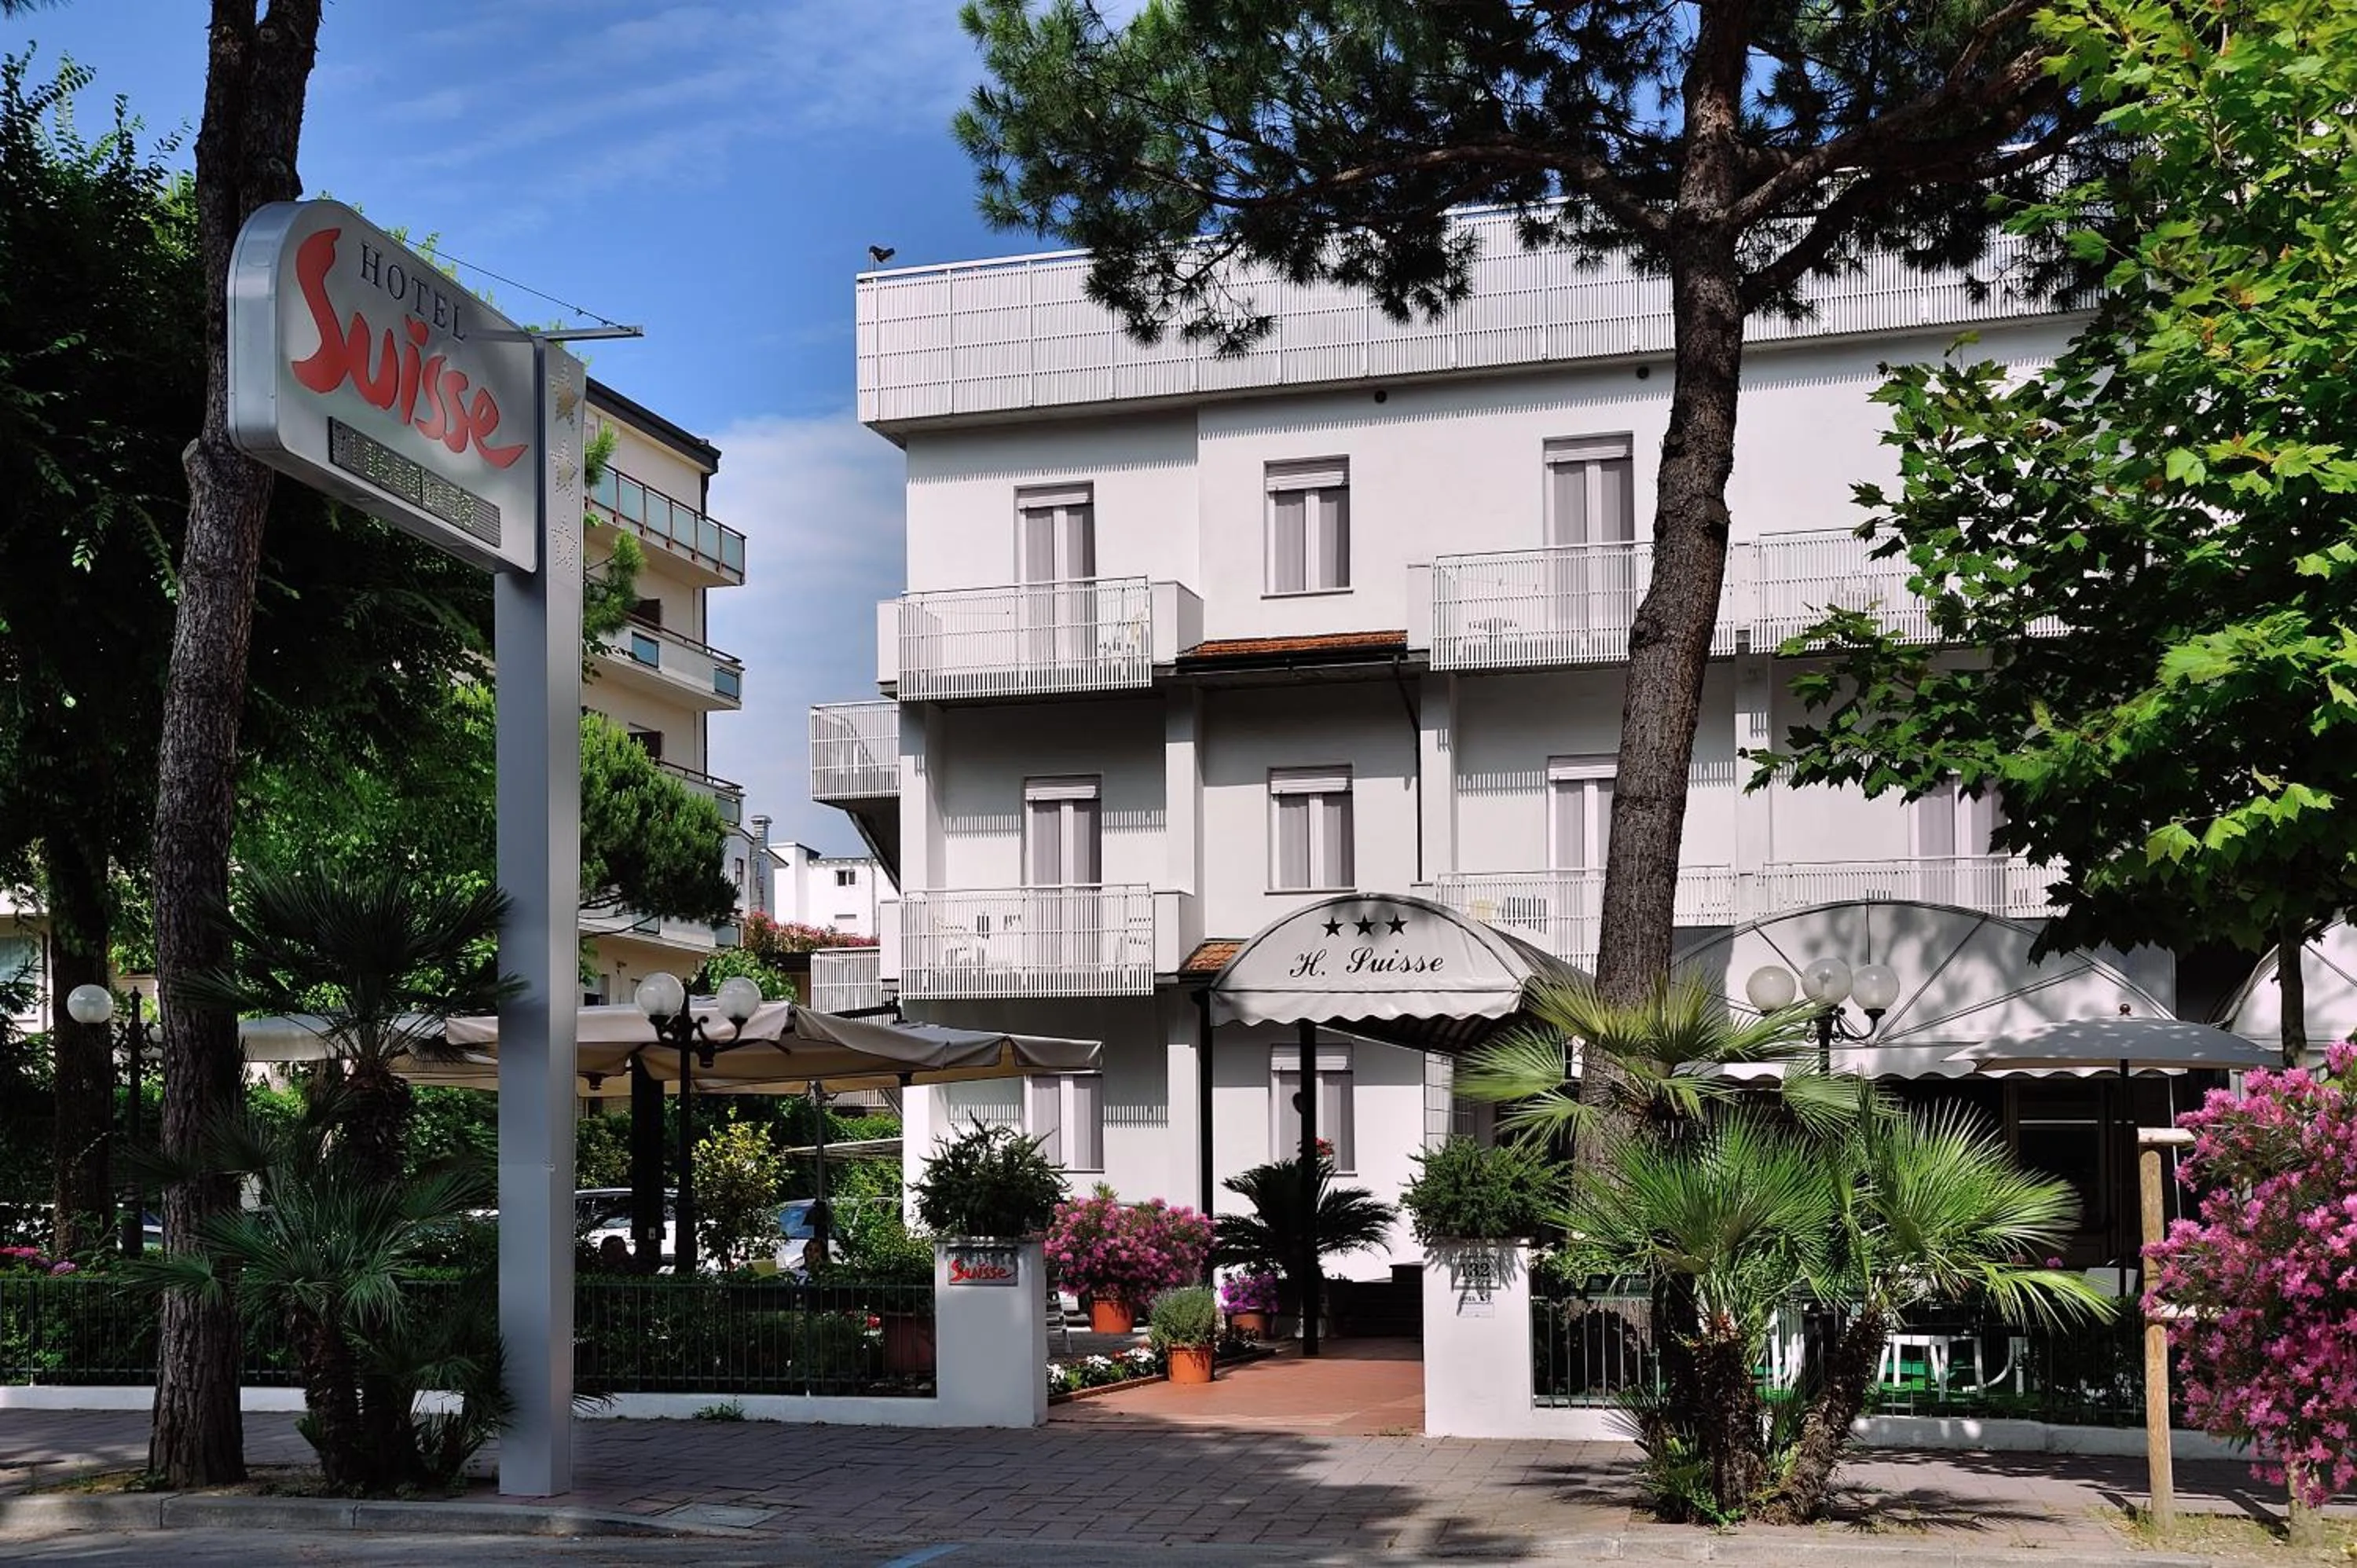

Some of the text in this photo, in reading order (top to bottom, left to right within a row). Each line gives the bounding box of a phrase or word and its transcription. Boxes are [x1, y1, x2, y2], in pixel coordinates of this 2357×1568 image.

[360, 242, 467, 342] HOTEL
[291, 227, 529, 469] Suisse
[1288, 946, 1444, 978] H. Suisse
[1461, 1262, 1490, 1277] 132
